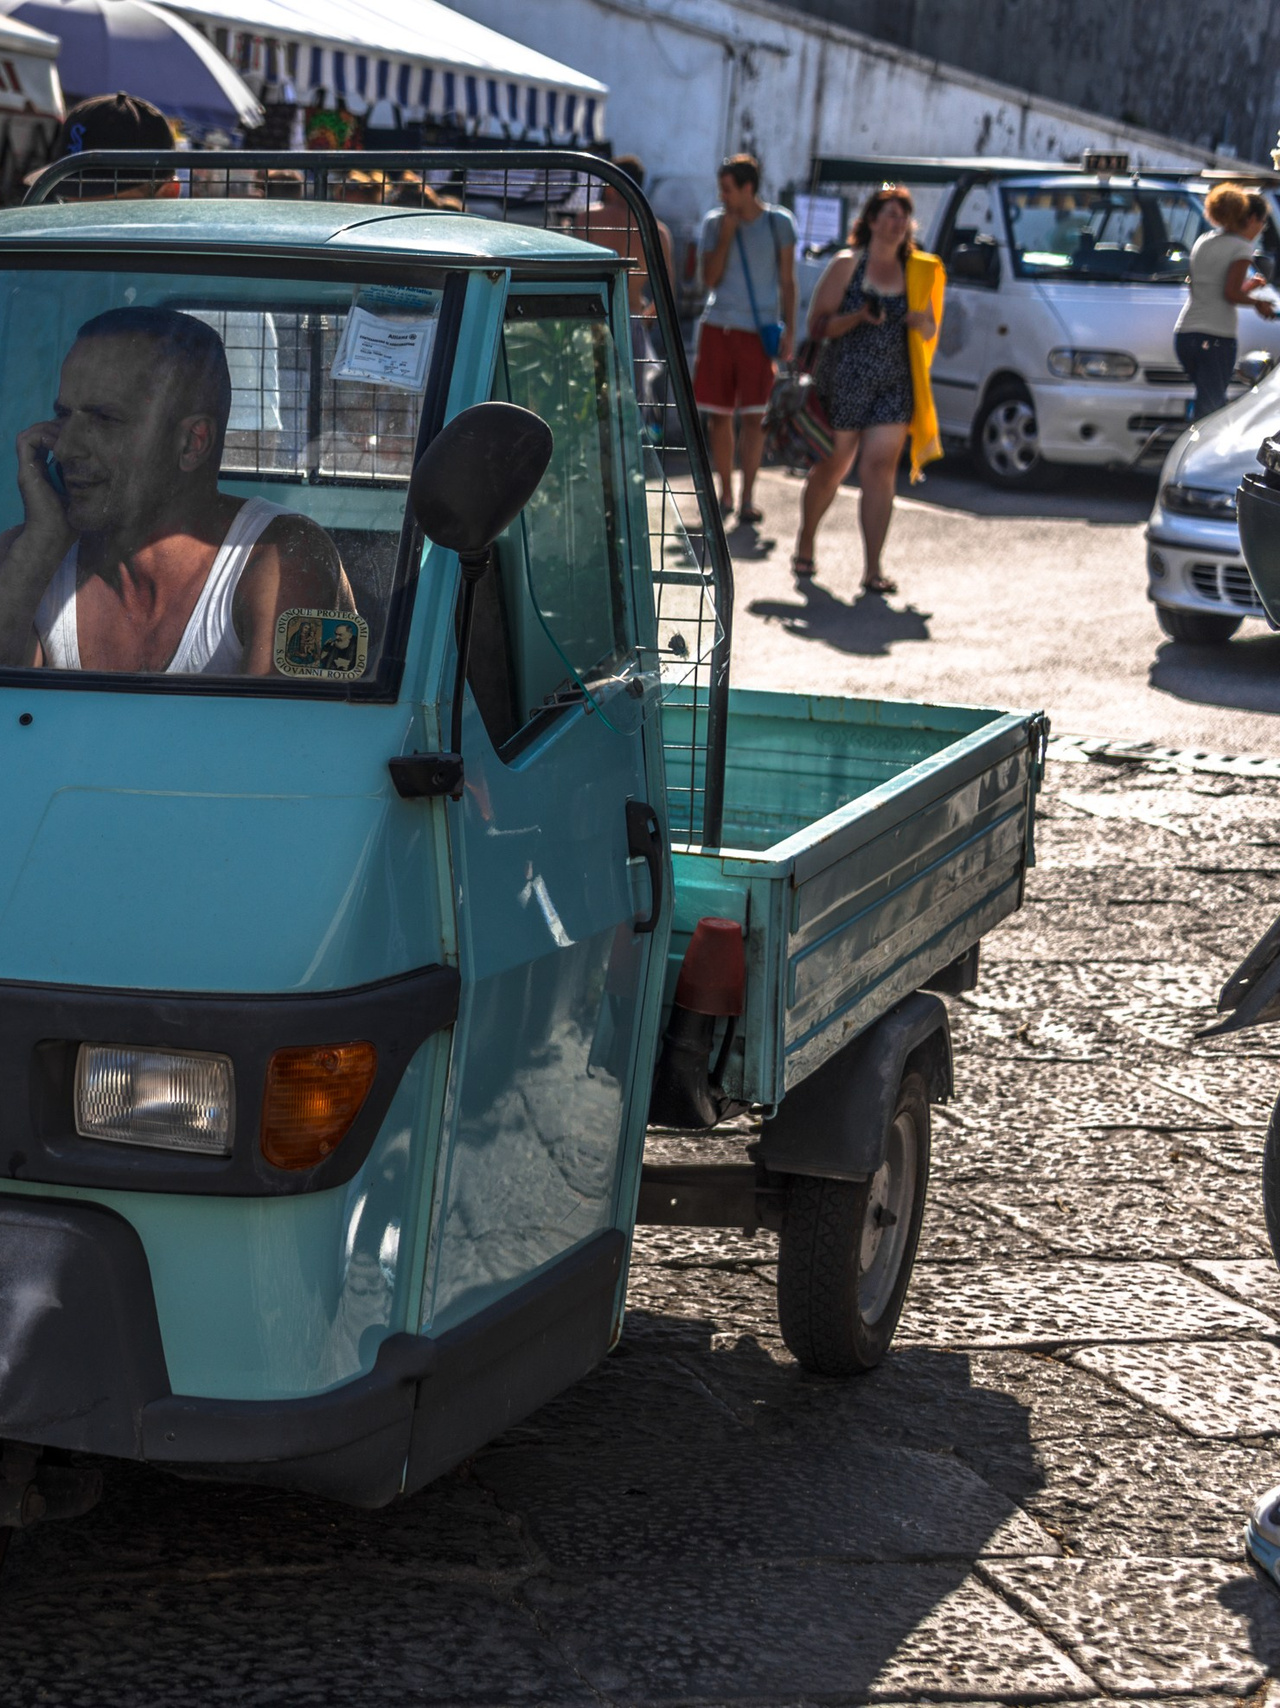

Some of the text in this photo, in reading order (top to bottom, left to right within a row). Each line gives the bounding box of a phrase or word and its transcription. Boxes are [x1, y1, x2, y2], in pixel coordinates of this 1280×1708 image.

[278, 608, 368, 638] OVUNQUE PROTEGGIMI
[327, 654, 366, 680] ROTONDO
